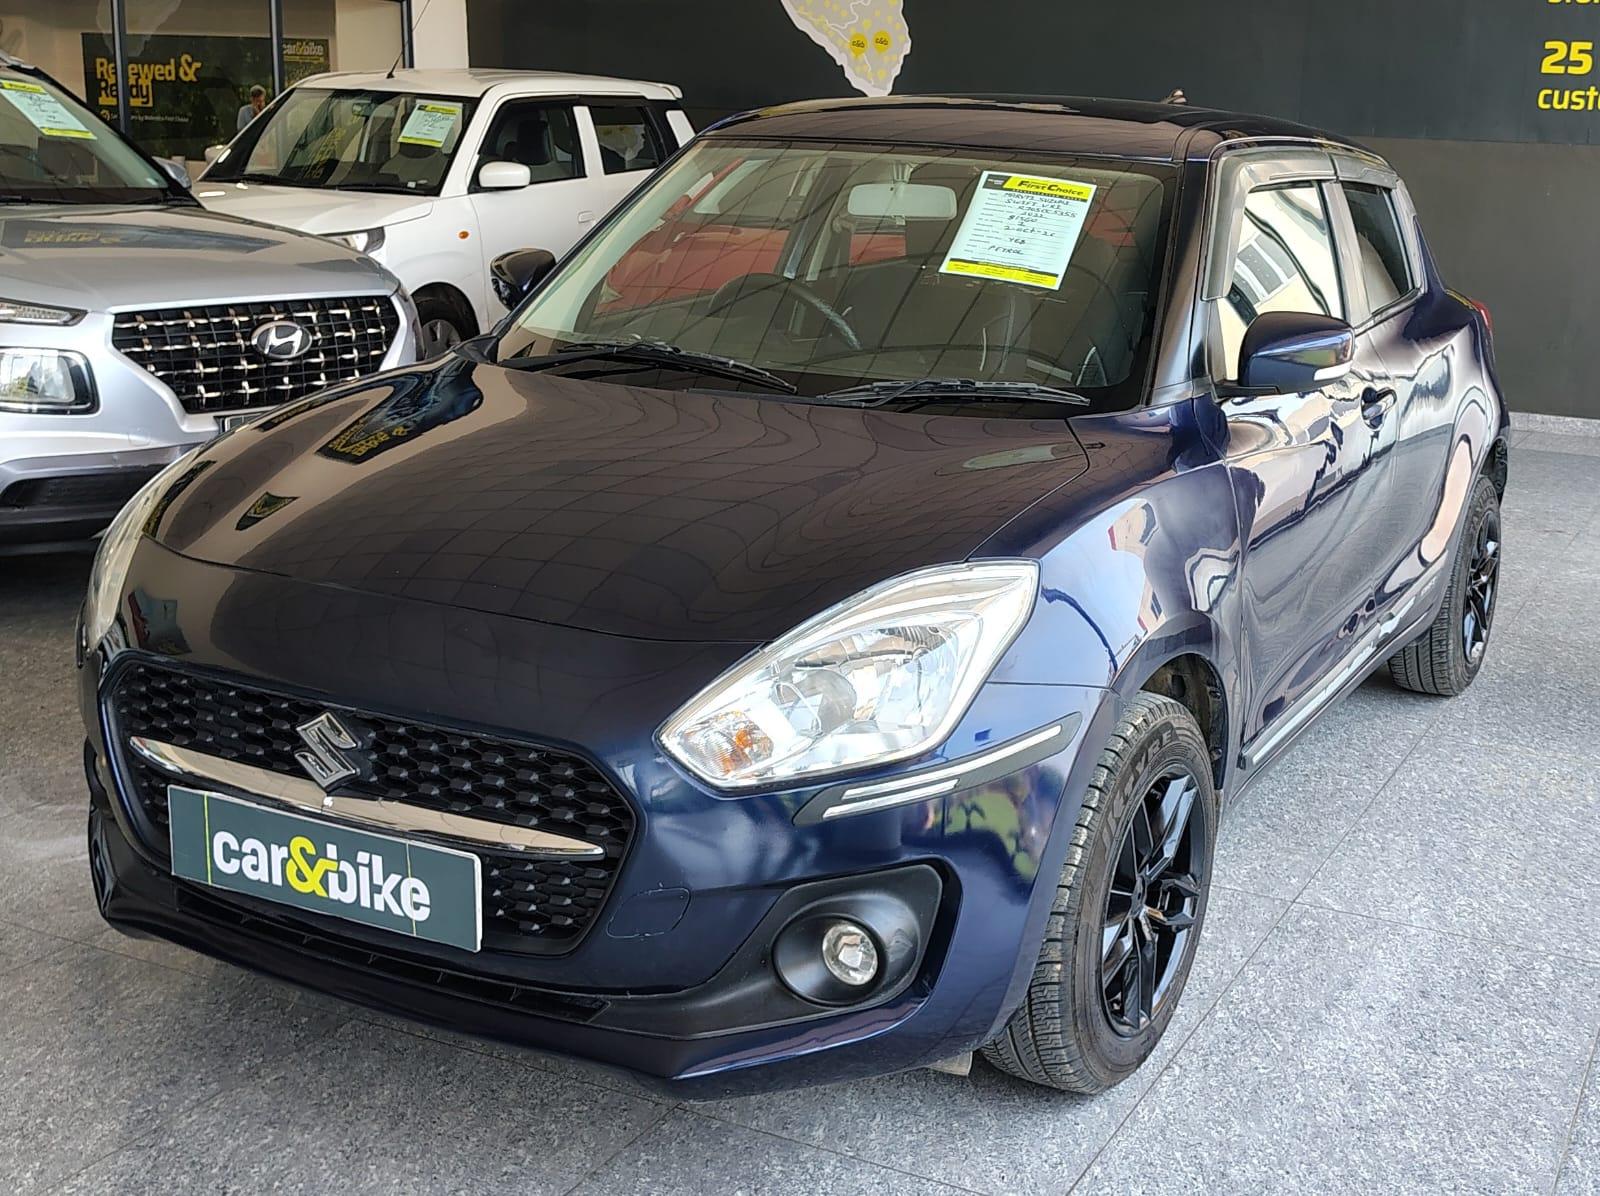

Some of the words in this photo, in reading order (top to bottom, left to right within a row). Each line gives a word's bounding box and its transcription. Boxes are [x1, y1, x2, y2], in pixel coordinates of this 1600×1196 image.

[95, 57, 175, 81] Reewed
[1541, 40, 1594, 75] 25
[100, 79, 150, 105] Redy
[1537, 85, 1600, 111] cust
[213, 830, 430, 922] car&bike
